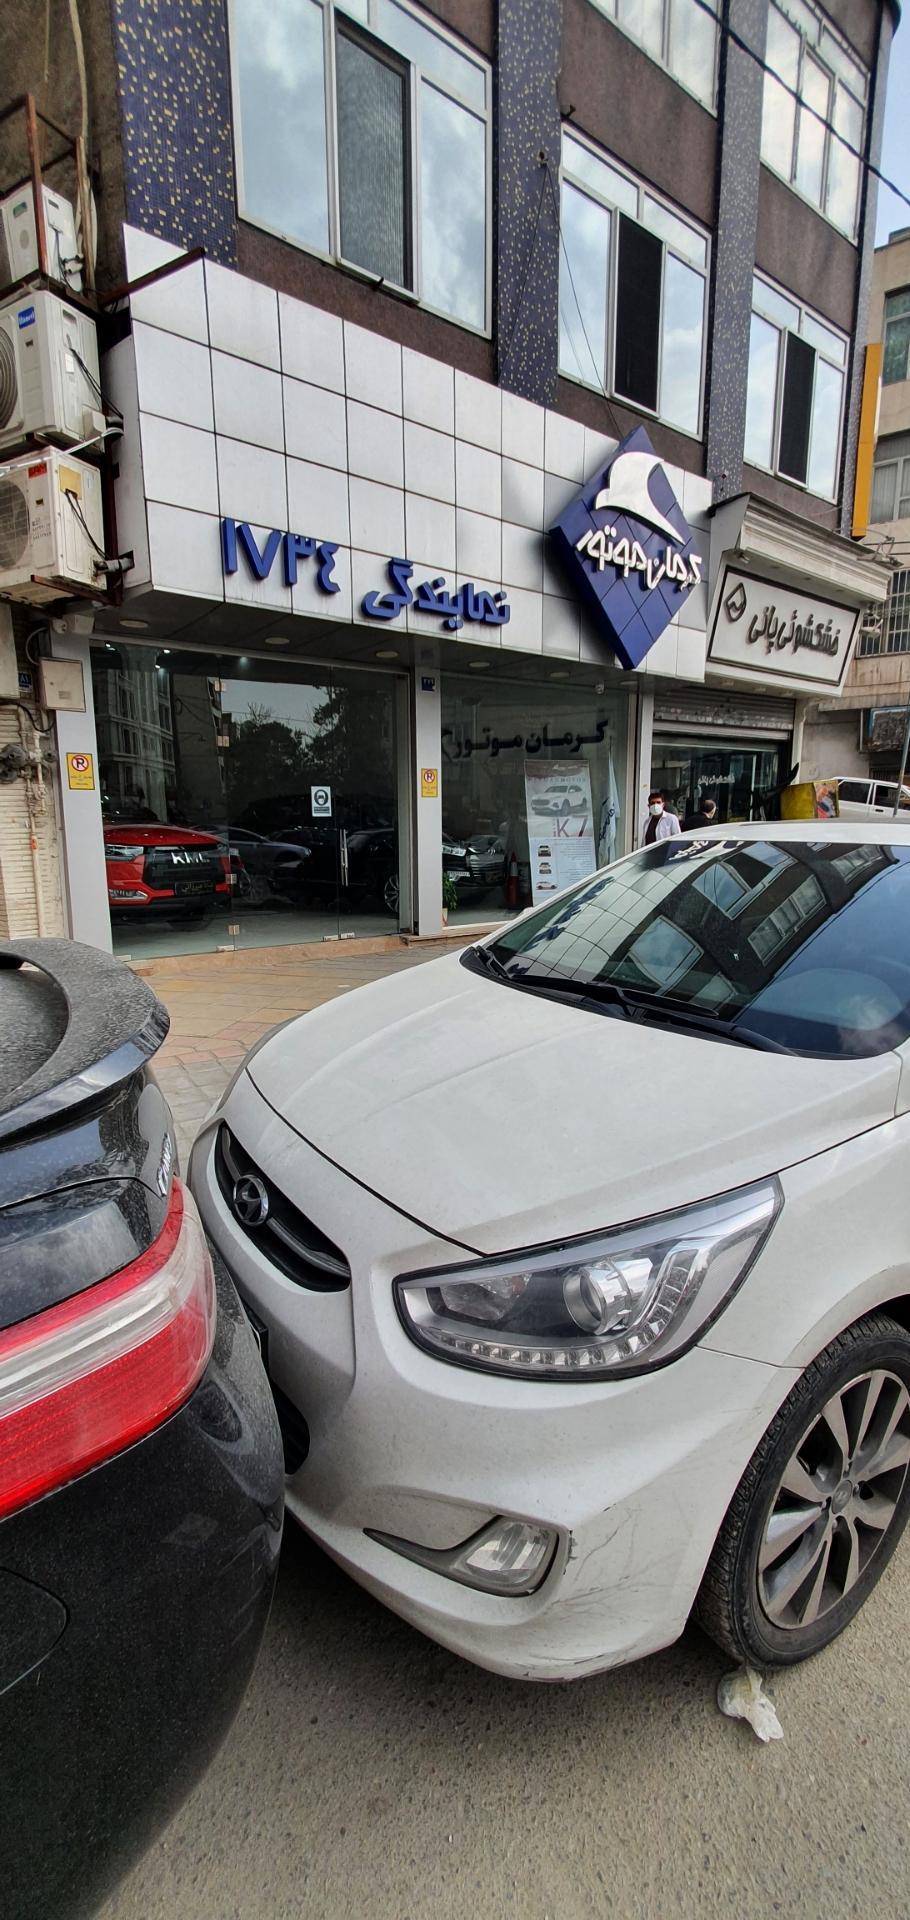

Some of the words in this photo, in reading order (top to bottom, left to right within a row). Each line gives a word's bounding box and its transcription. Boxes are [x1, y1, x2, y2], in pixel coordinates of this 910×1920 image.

[576, 524, 648, 578] موتور
[361, 558, 511, 632] نمایندگی
[453, 727, 523, 759] موتور
[525, 719, 609, 754] کرمان
